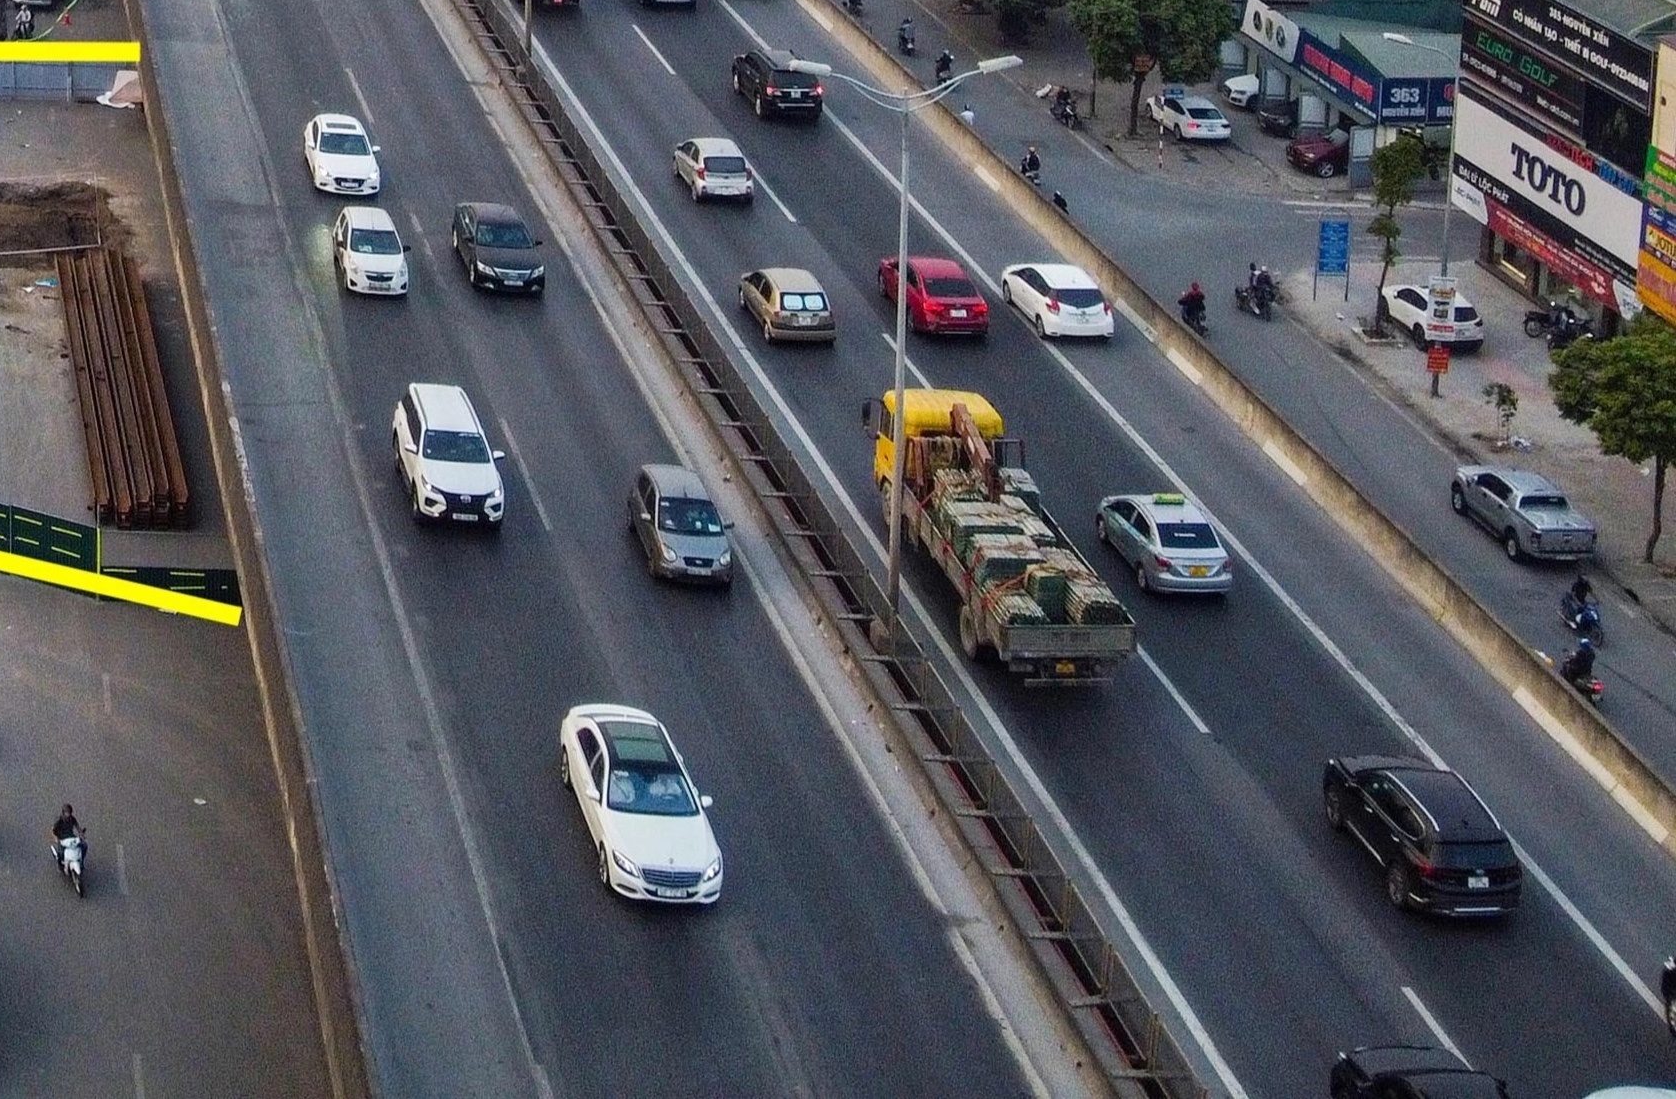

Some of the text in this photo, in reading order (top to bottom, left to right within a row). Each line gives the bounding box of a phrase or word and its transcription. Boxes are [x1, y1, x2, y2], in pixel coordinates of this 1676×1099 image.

[1476, 32, 1513, 64] EURO
[1519, 55, 1559, 88] GOLF
[1390, 88, 1420, 103] 363
[1510, 142, 1586, 216] TOTO
